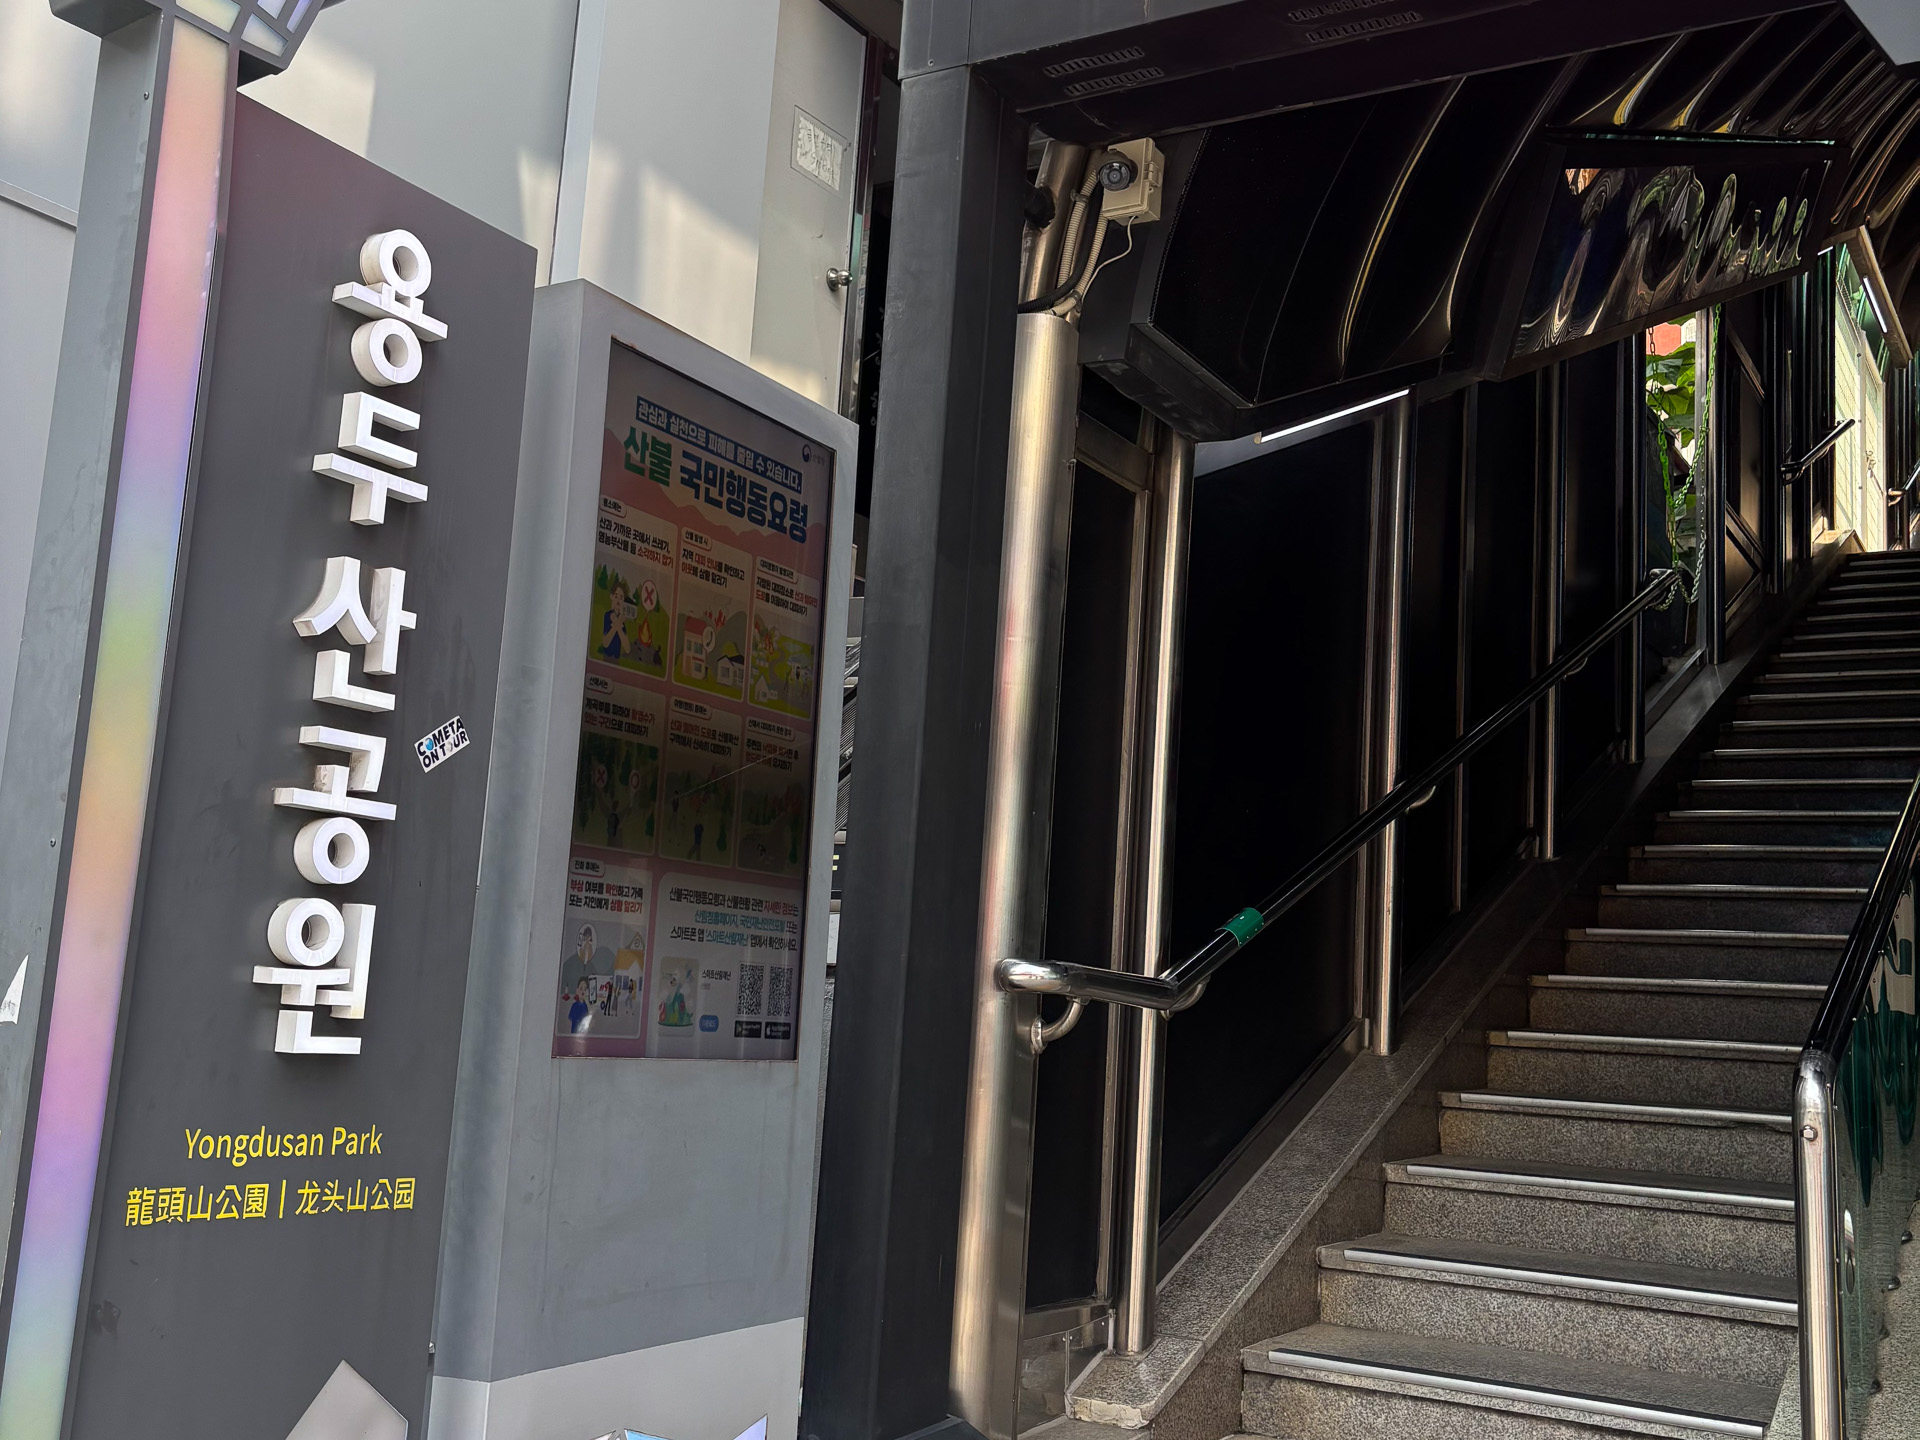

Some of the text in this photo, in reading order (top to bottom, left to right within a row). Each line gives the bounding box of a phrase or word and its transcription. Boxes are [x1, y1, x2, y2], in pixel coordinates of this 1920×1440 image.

[638, 400, 801, 492] 관심과 실천으로 피해를 줄일 수 있습니다.
[623, 426, 809, 544] 산불 국민행동요령
[598, 531, 674, 569] 영농부산물 등 소각하지 않기
[600, 516, 671, 555] 산과 가까운 곳에서 쓰레기,
[682, 548, 745, 581] 지역 대피 안내를 확인하고
[252, 229, 449, 1056] 용두산공원
[417, 718, 464, 757] COMETA
[624, 722, 648, 738] 대피하기
[422, 749, 440, 768] ON
[568, 894, 643, 914] 또는 지인에게 상황 알리기
[570, 878, 644, 901] 부상 여부를 확인하고 가족
[669, 886, 726, 908] 산불국민행동요령과
[670, 926, 697, 942] 스마트폰
[698, 928, 705, 943] 앱
[185, 1124, 383, 1168] Yongdusan Park
[125, 1177, 416, 1227] 龍頭山公園 龙头山公园
